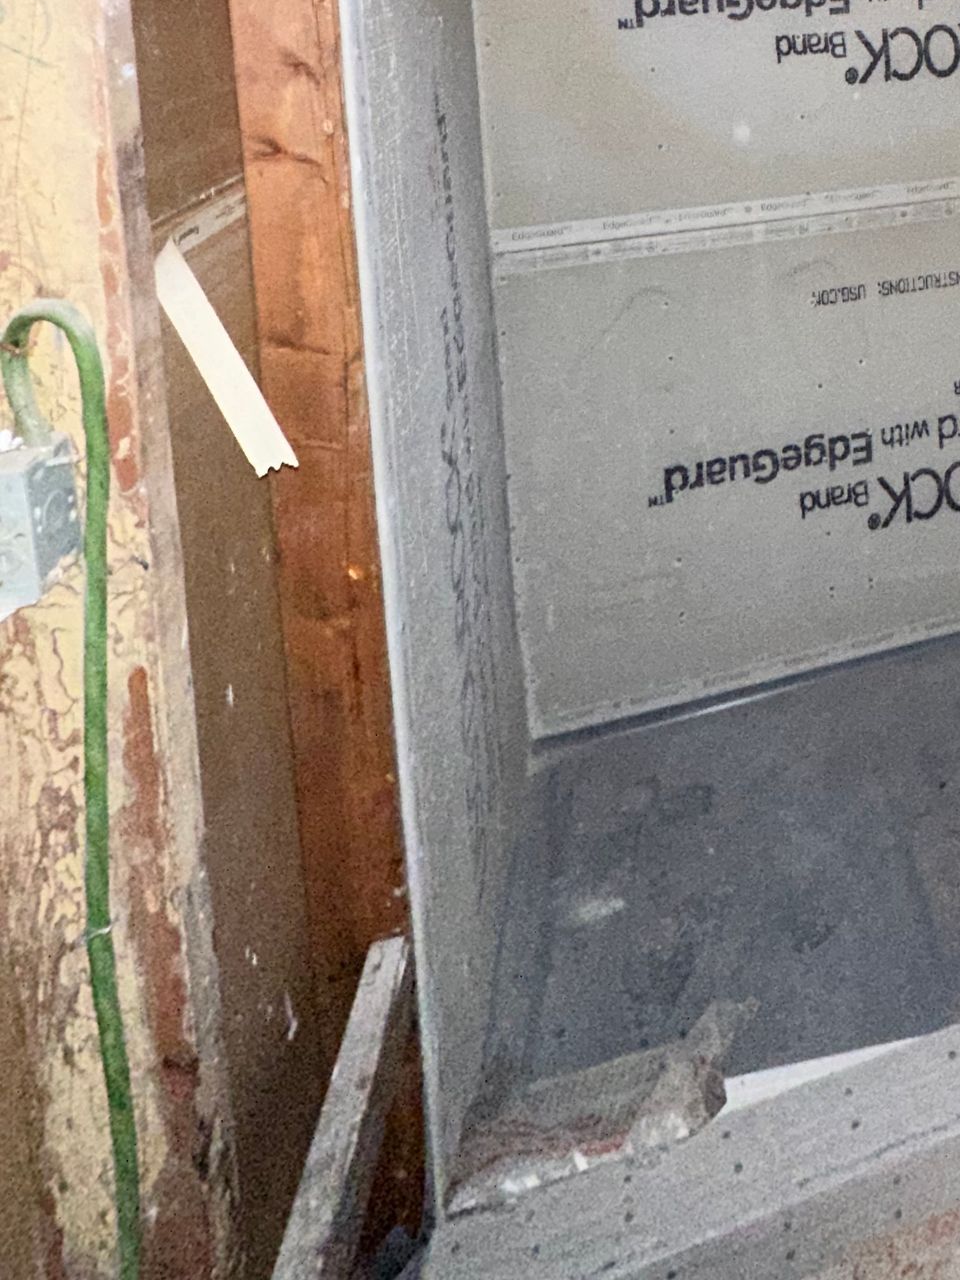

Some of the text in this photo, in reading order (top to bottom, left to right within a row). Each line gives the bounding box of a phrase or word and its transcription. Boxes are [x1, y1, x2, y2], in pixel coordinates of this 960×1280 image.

[775, 30, 847, 64] Brand
[881, 419, 930, 448] with
[800, 481, 869, 519] Brand
